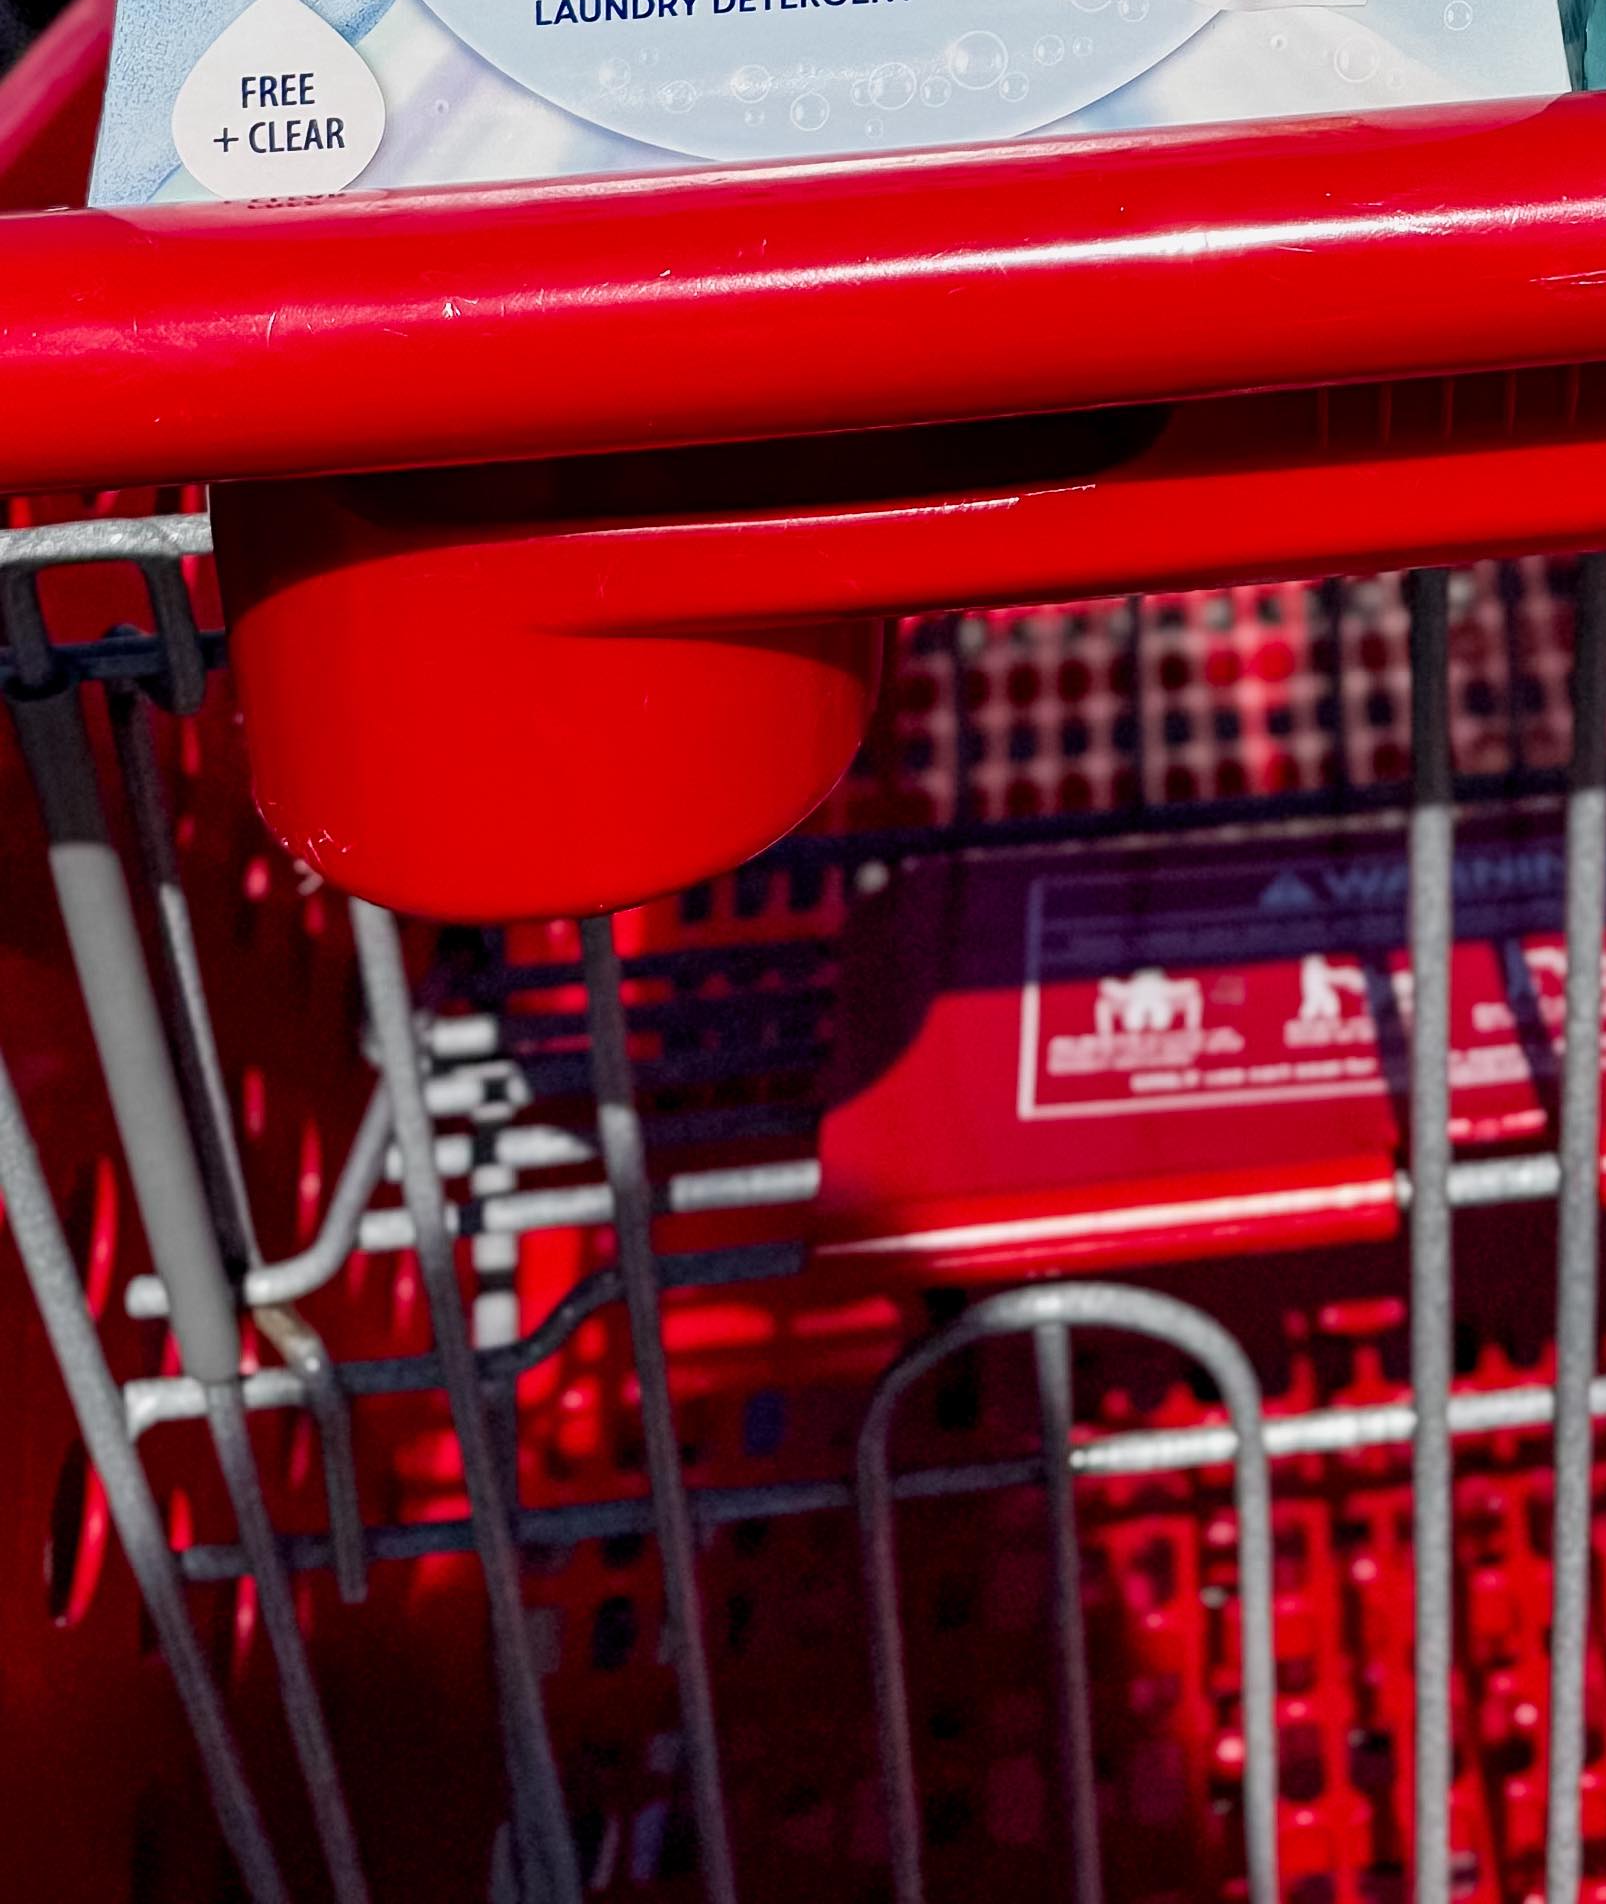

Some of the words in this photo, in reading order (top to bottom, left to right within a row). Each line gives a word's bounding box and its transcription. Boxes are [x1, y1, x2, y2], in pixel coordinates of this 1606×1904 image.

[241, 72, 316, 109] FREE
[213, 127, 239, 152] +
[248, 117, 345, 154] CLEAR
